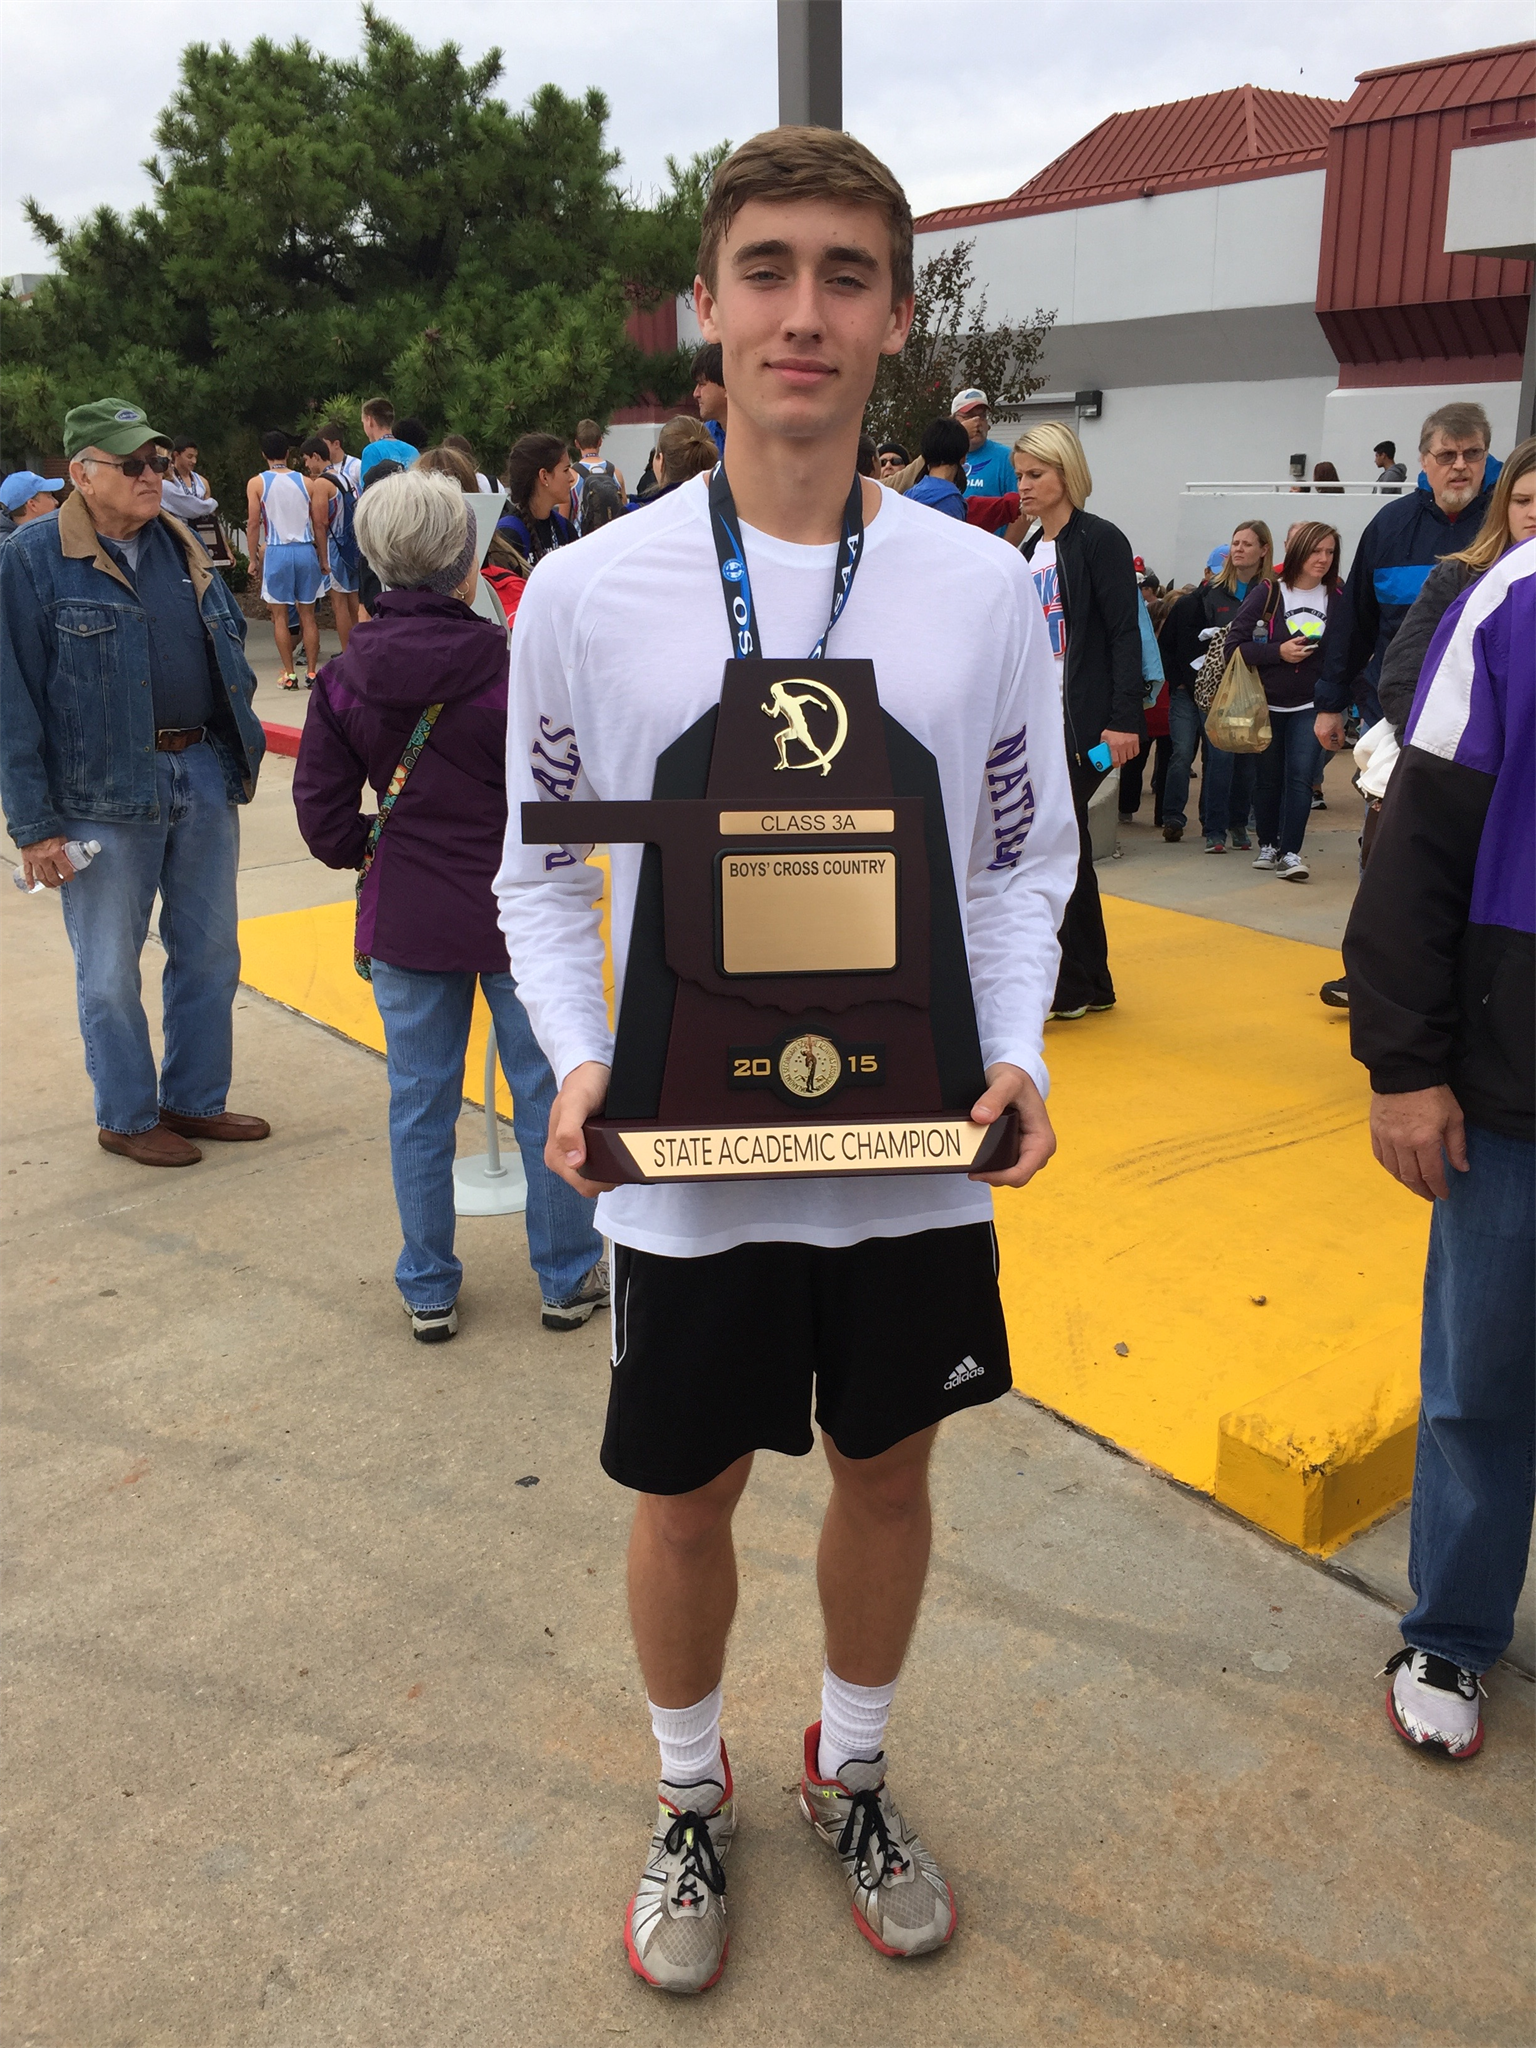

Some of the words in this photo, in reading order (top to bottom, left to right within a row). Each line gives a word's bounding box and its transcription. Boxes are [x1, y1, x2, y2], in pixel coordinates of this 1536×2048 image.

[761, 815, 826, 832] CLASS
[832, 814, 857, 831] 3A
[729, 861, 770, 878] BOYS'
[773, 860, 819, 877] CROSS
[823, 859, 887, 876] COUNTRY
[733, 1058, 771, 1077] 20
[848, 1055, 878, 1073] 15
[653, 1136, 713, 1168] STATE
[718, 1132, 836, 1166] ACADEMIC
[841, 1128, 962, 1161] CHAMPION
[943, 1366, 985, 1390] adidas
